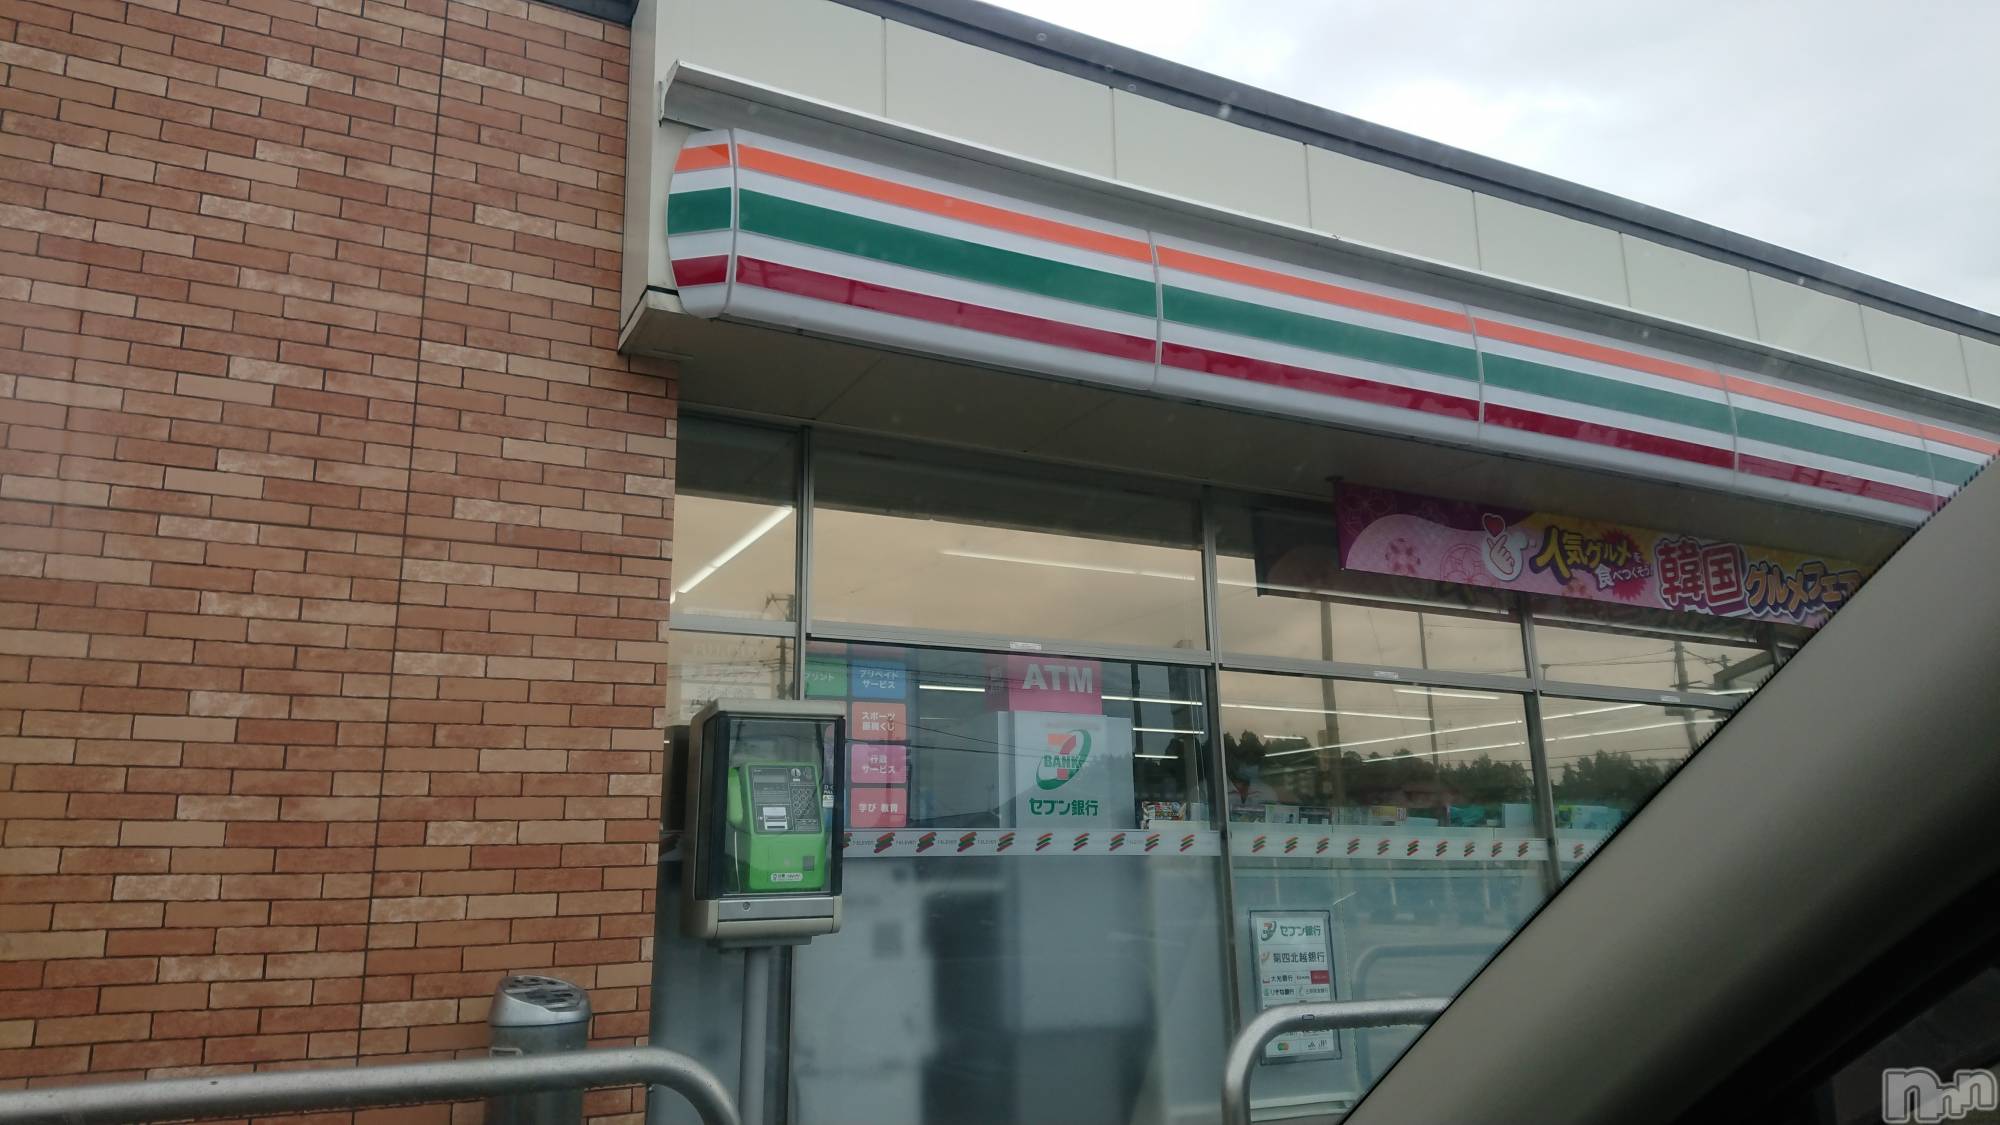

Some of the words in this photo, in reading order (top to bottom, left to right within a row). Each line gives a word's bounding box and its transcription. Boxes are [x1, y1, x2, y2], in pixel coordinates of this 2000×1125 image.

[862, 680, 896, 689] サービス
[1022, 663, 1094, 694] ATM
[861, 711, 896, 721] スポーツ
[1043, 754, 1080, 769] BANK
[861, 765, 896, 774] サービス
[1029, 798, 1099, 817] セブン銀行
[1279, 925, 1321, 937] セブン銀行
